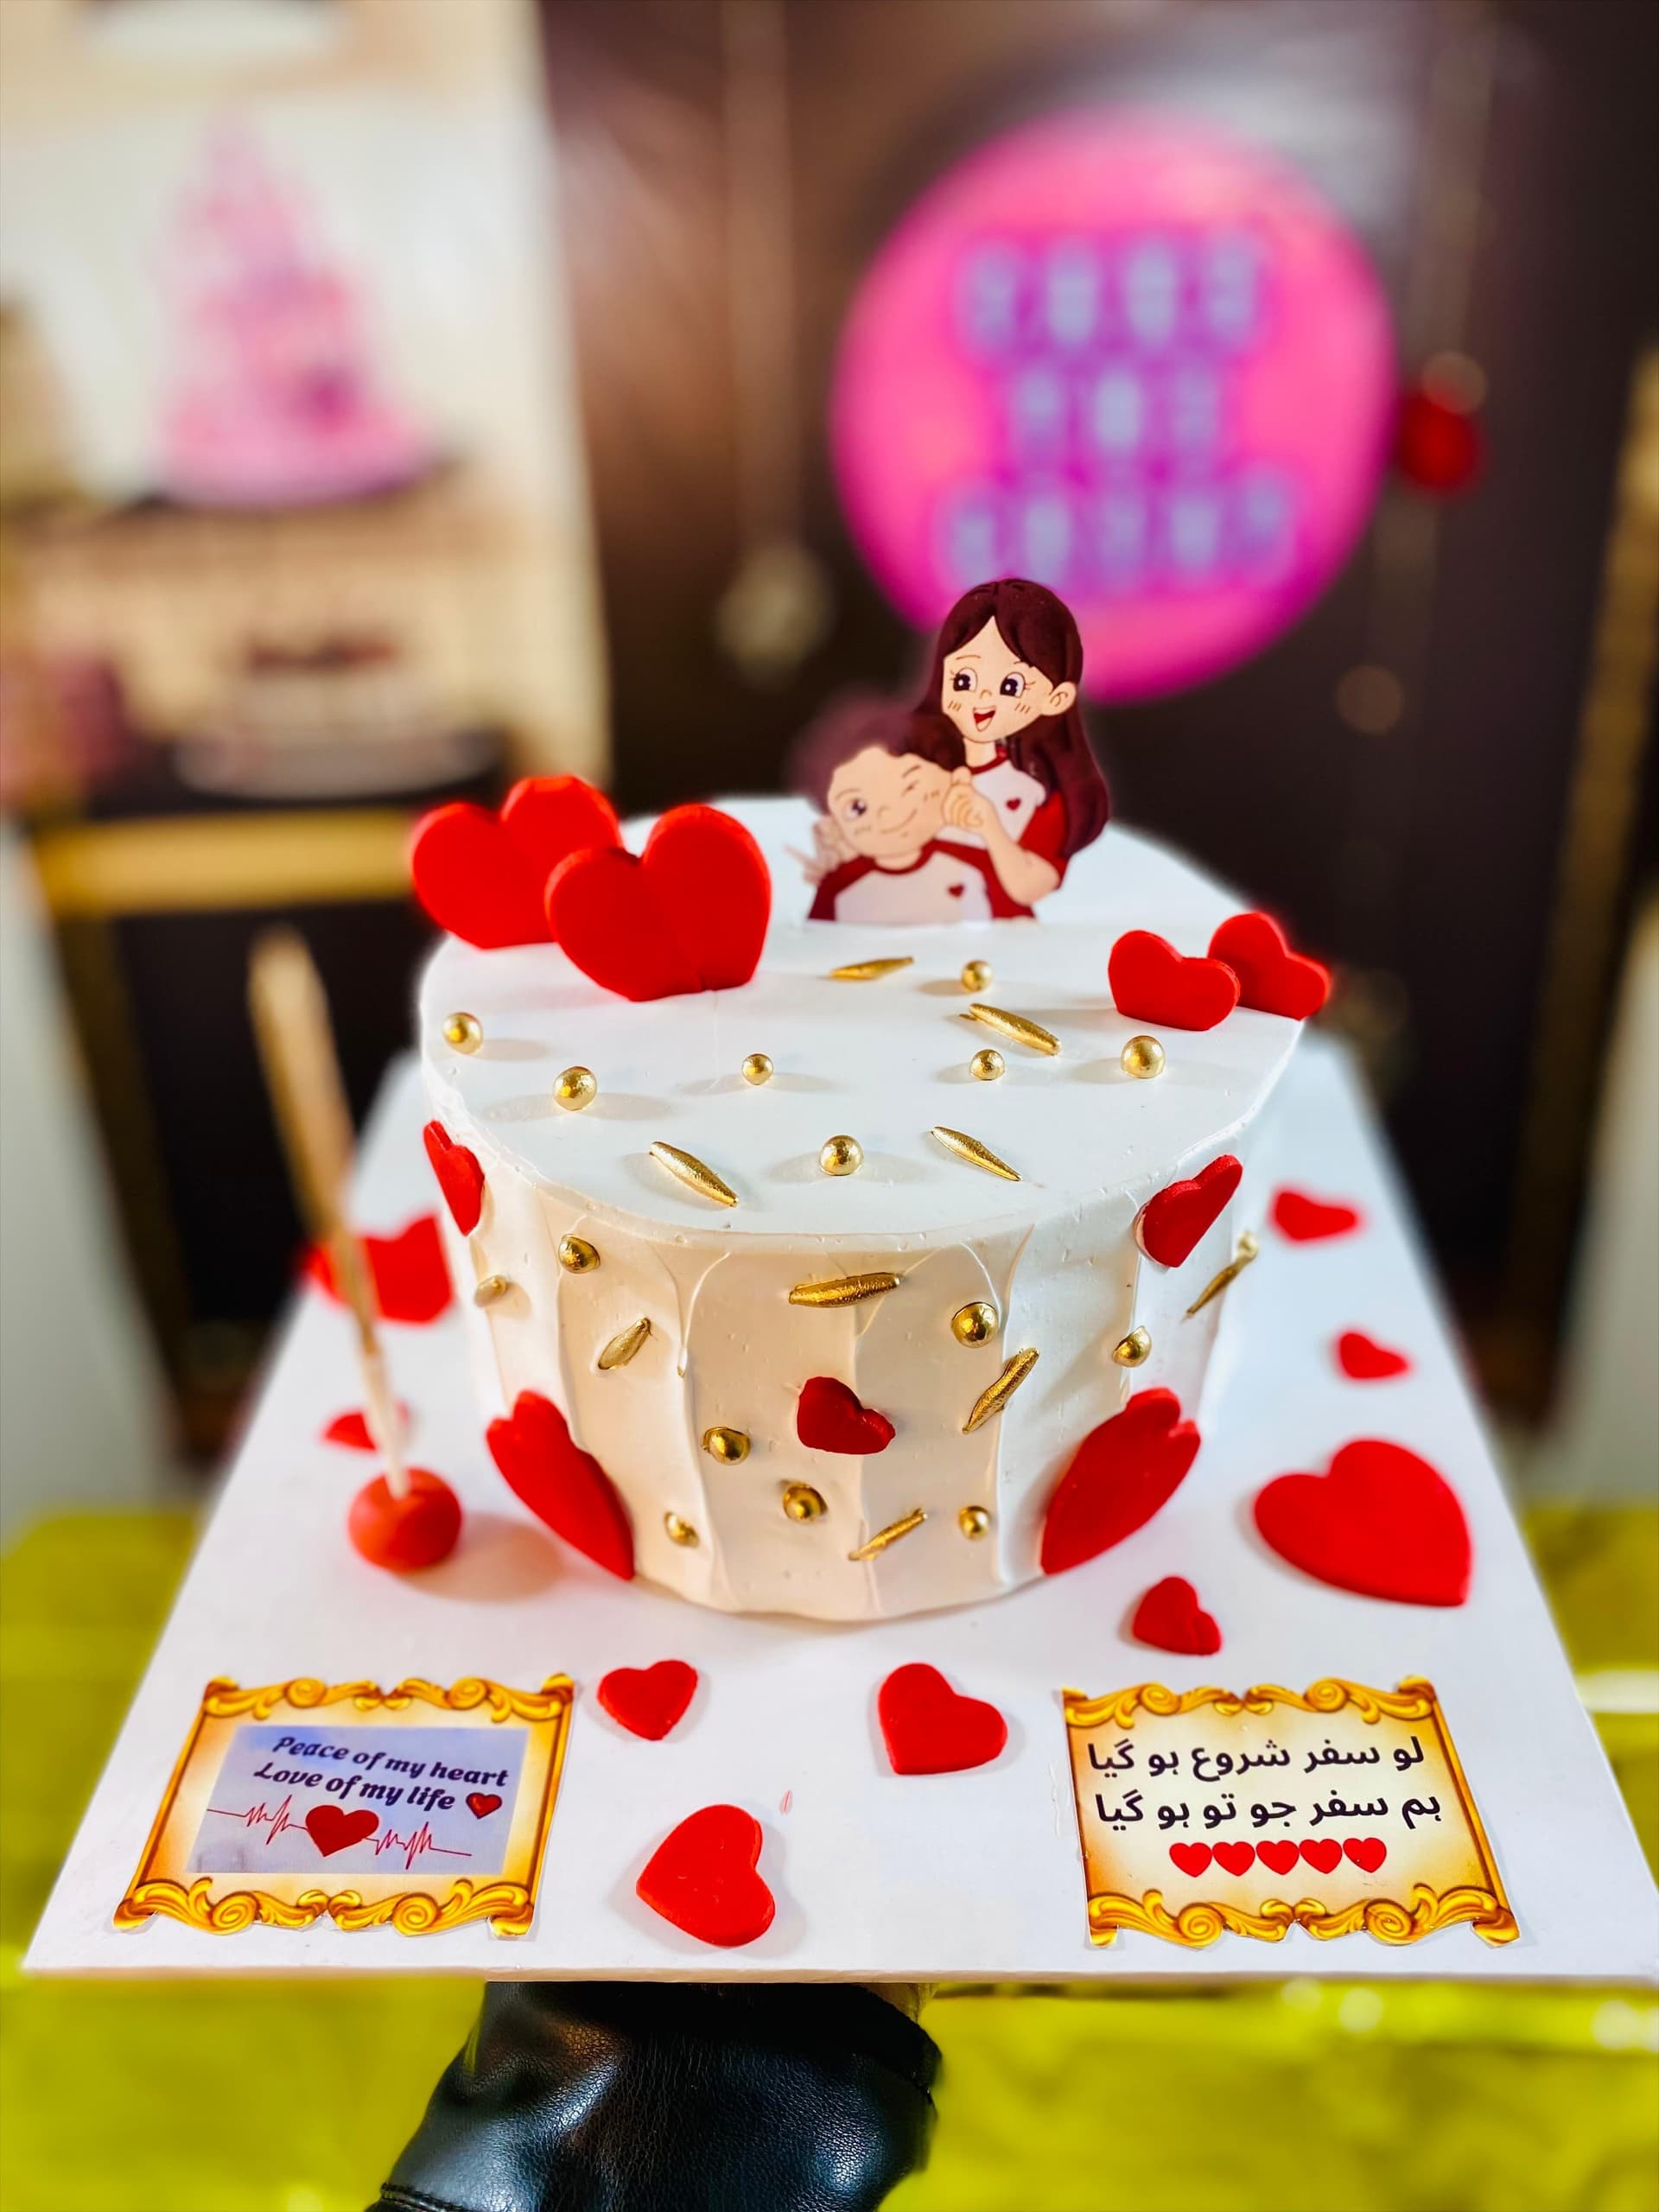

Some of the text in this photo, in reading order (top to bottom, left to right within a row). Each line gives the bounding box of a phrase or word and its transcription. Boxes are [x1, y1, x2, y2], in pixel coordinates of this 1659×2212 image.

[272, 1737, 509, 1787] Peace of my heart
[1192, 1739, 1290, 1783] شروع
[1304, 1738, 1380, 1774] سفر
[1393, 1736, 1424, 1771] لو
[253, 1762, 456, 1812] Love of my life
[1203, 1793, 1236, 1829] تو
[1250, 1802, 1297, 1828] جو
[1309, 1789, 1389, 1827] سفر
